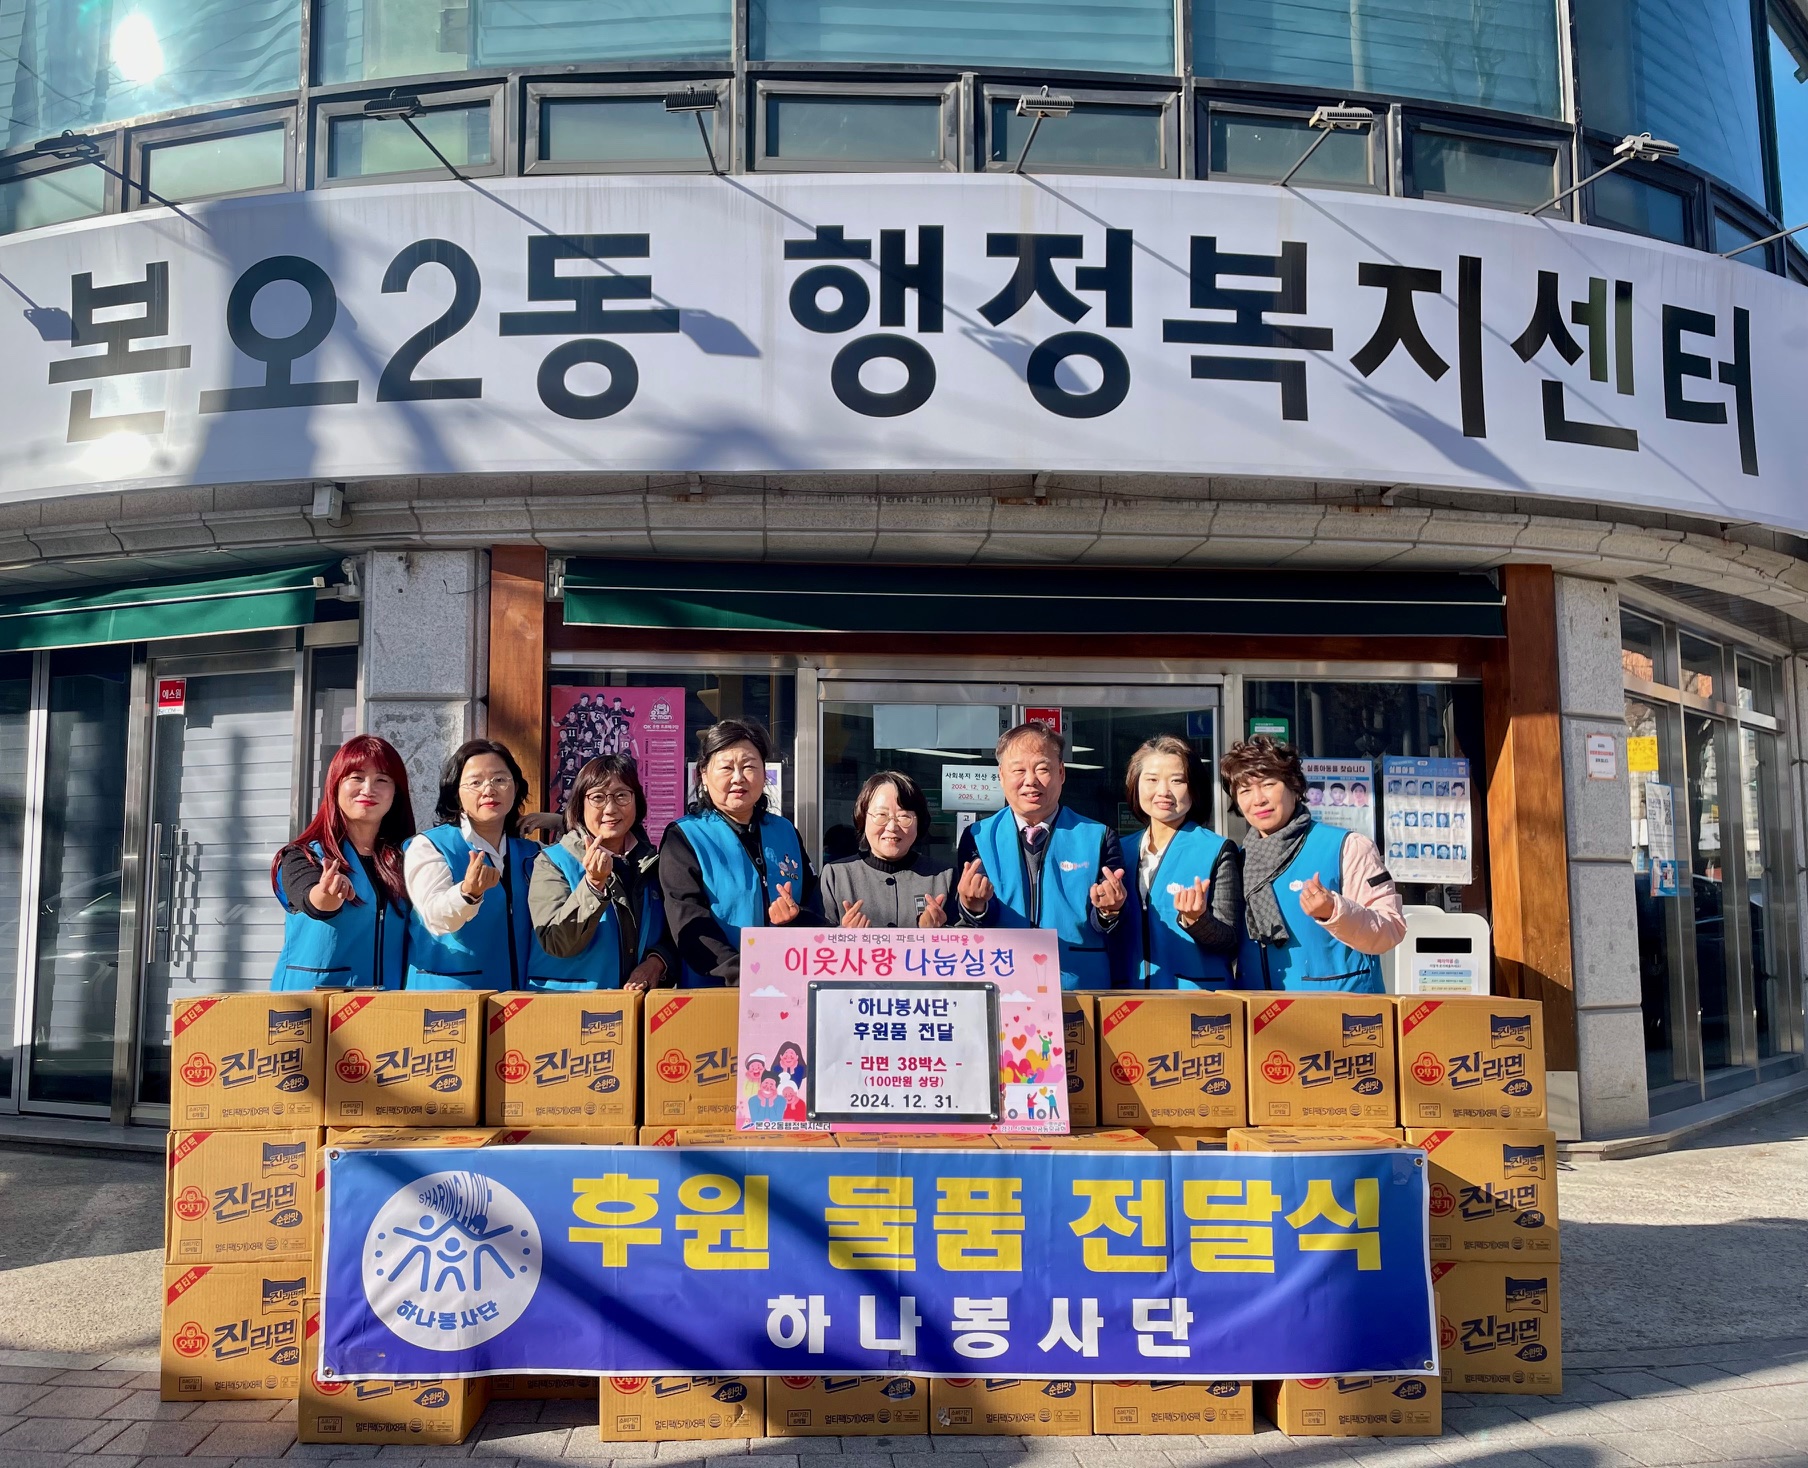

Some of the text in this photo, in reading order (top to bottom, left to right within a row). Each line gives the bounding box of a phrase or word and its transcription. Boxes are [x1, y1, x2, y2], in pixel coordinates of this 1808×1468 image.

[48, 225, 1759, 475] 본오2동 행정복지센터
[162, 689, 181, 699] 에스원
[945, 772, 971, 780] 사회복지
[1307, 764, 1366, 773] 실종아동을 찾습니다
[828, 933, 970, 945] 변화와 희망의 파트너 보니마을
[784, 947, 1015, 977] 이웃사랑 나눔실천
[181, 1003, 204, 1025] 멀티팩
[338, 999, 359, 1021] 멀티팩
[497, 1002, 519, 1022] 멀티팩
[1109, 1005, 1130, 1025] 멀티팩
[1260, 1003, 1282, 1023] 멀티팩
[1409, 1004, 1430, 1024] 멀티팩
[853, 1022, 954, 1041] 후원품 전달
[219, 1047, 303, 1089] 진라면
[342, 1062, 365, 1075] 오뚜기
[374, 1047, 458, 1087] 진라면
[502, 1063, 524, 1076] 오뚜기
[533, 1048, 615, 1086] 진라면
[662, 1063, 685, 1075] 오뚜기
[861, 1056, 947, 1072] 라면 38박스
[1115, 1066, 1138, 1077] 오뚜기
[1147, 1051, 1224, 1089] 진라면
[1267, 1065, 1291, 1078] 오뚜기
[1298, 1051, 1377, 1088] 진라면
[1448, 1051, 1526, 1090] 진라면
[186, 1067, 210, 1079] 오뚜기
[1417, 1066, 1441, 1079] 오뚜기
[282, 1076, 305, 1090] 순한맛
[436, 1076, 458, 1090] 순한맛
[594, 1077, 616, 1090] 순한맛
[864, 1075, 944, 1089] (100만원 상당)
[1206, 1080, 1228, 1093] 순한맛
[1358, 1079, 1380, 1094] 순한맛
[1507, 1081, 1530, 1095] 순한맛
[850, 1095, 959, 1109] 2024. 12. 31.
[174, 1137, 197, 1158] 멀티팩
[180, 1202, 203, 1214] 오뚜기
[212, 1182, 297, 1222] 진라면
[1458, 1182, 1538, 1221] 진라면
[276, 1212, 298, 1225] 순한맛
[569, 1173, 1382, 1273] 후원 물품 전달식
[1520, 1213, 1541, 1226] 순한맛
[396, 1299, 501, 1329] 하나봉사단
[212, 1319, 296, 1361] 진라면
[1459, 1315, 1541, 1355] 진라면
[179, 1340, 203, 1351] 오뚜기
[1522, 1347, 1543, 1359] 순한맛
[275, 1349, 299, 1363] 순한맛
[719, 1386, 743, 1400] 순한맛
[888, 1379, 912, 1396] 순한맛
[1049, 1380, 1073, 1396] 순한맛
[1213, 1381, 1236, 1395] 순한맛
[1400, 1382, 1423, 1398] 순한맛
[421, 1391, 446, 1406] 순한맛
